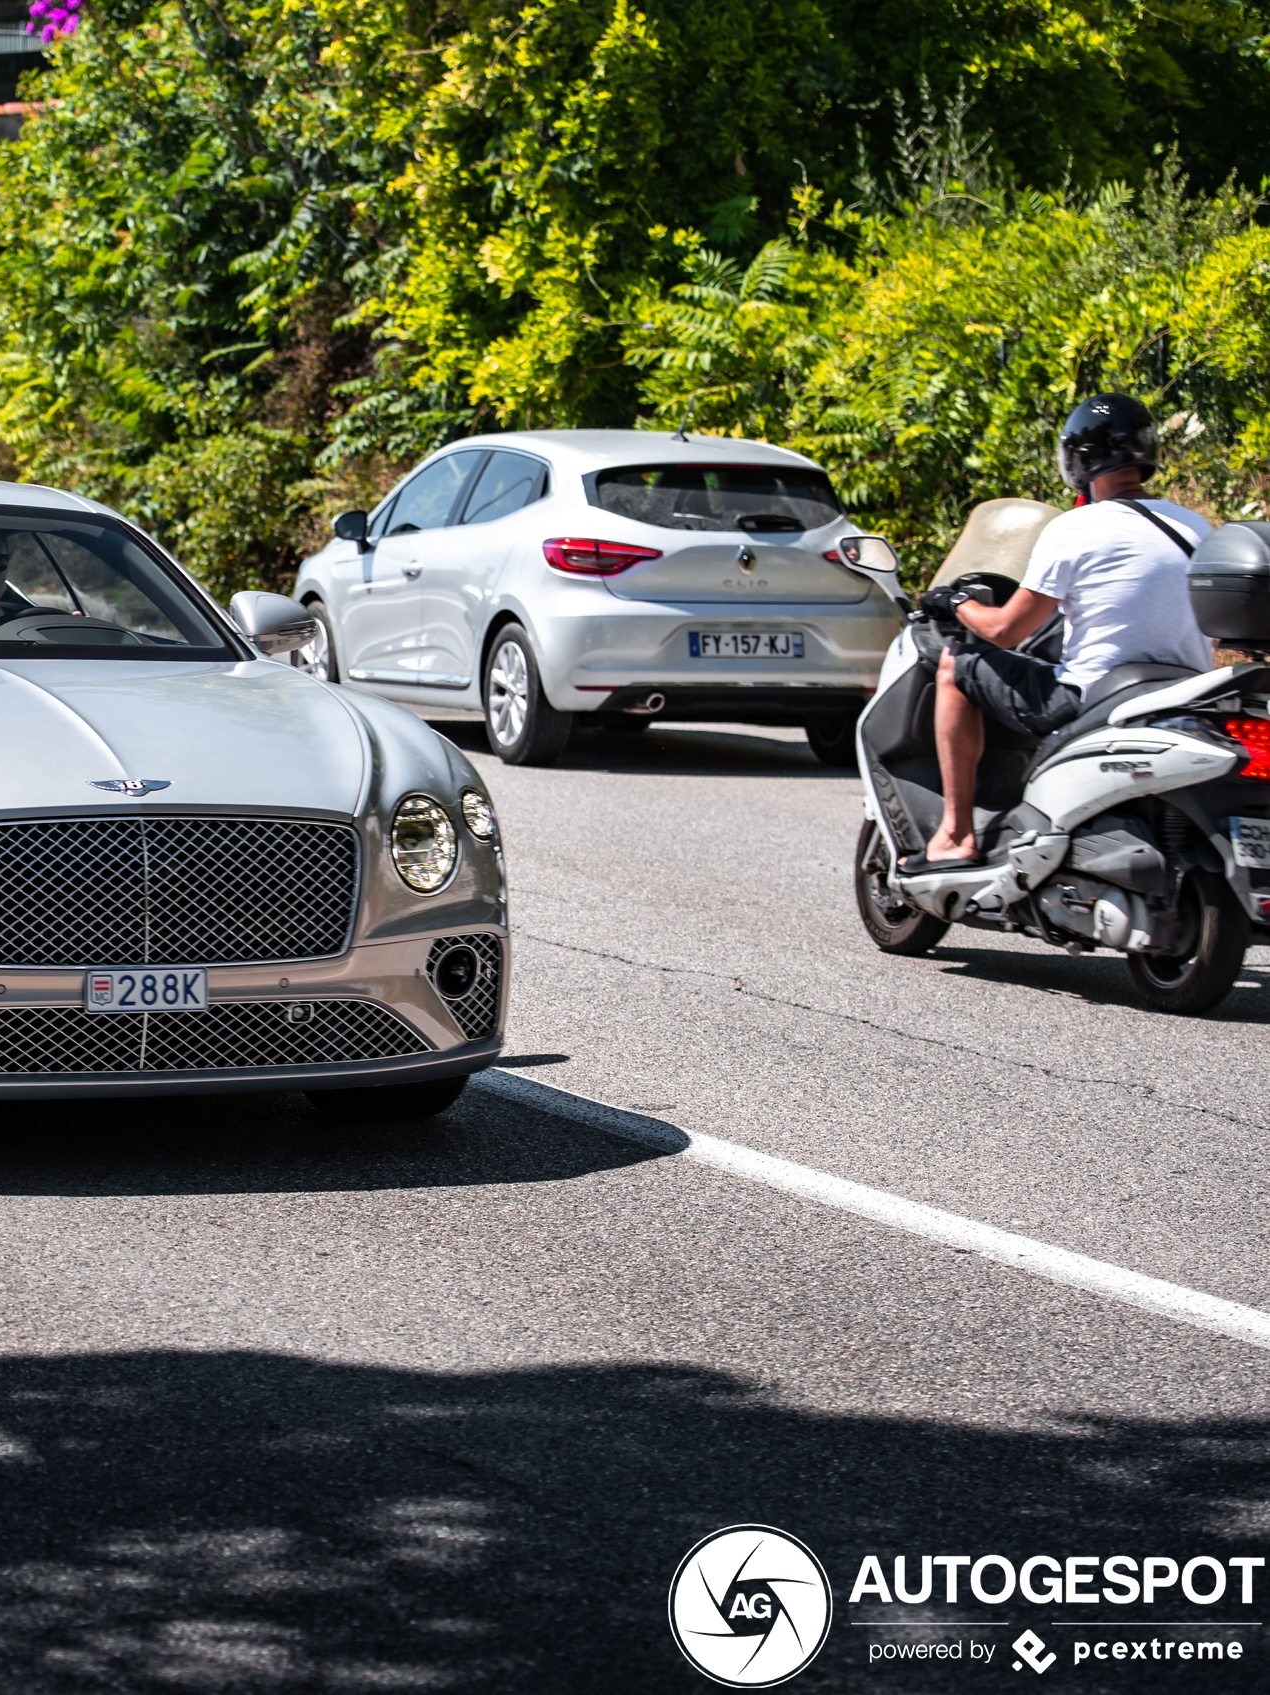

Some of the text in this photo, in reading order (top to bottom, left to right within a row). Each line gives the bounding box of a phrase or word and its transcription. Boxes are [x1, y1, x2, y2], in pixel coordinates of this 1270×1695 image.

[723, 579, 768, 588] CLIO
[701, 634, 790, 655] FY-157-KJ
[94, 973, 200, 1006] MC 288K
